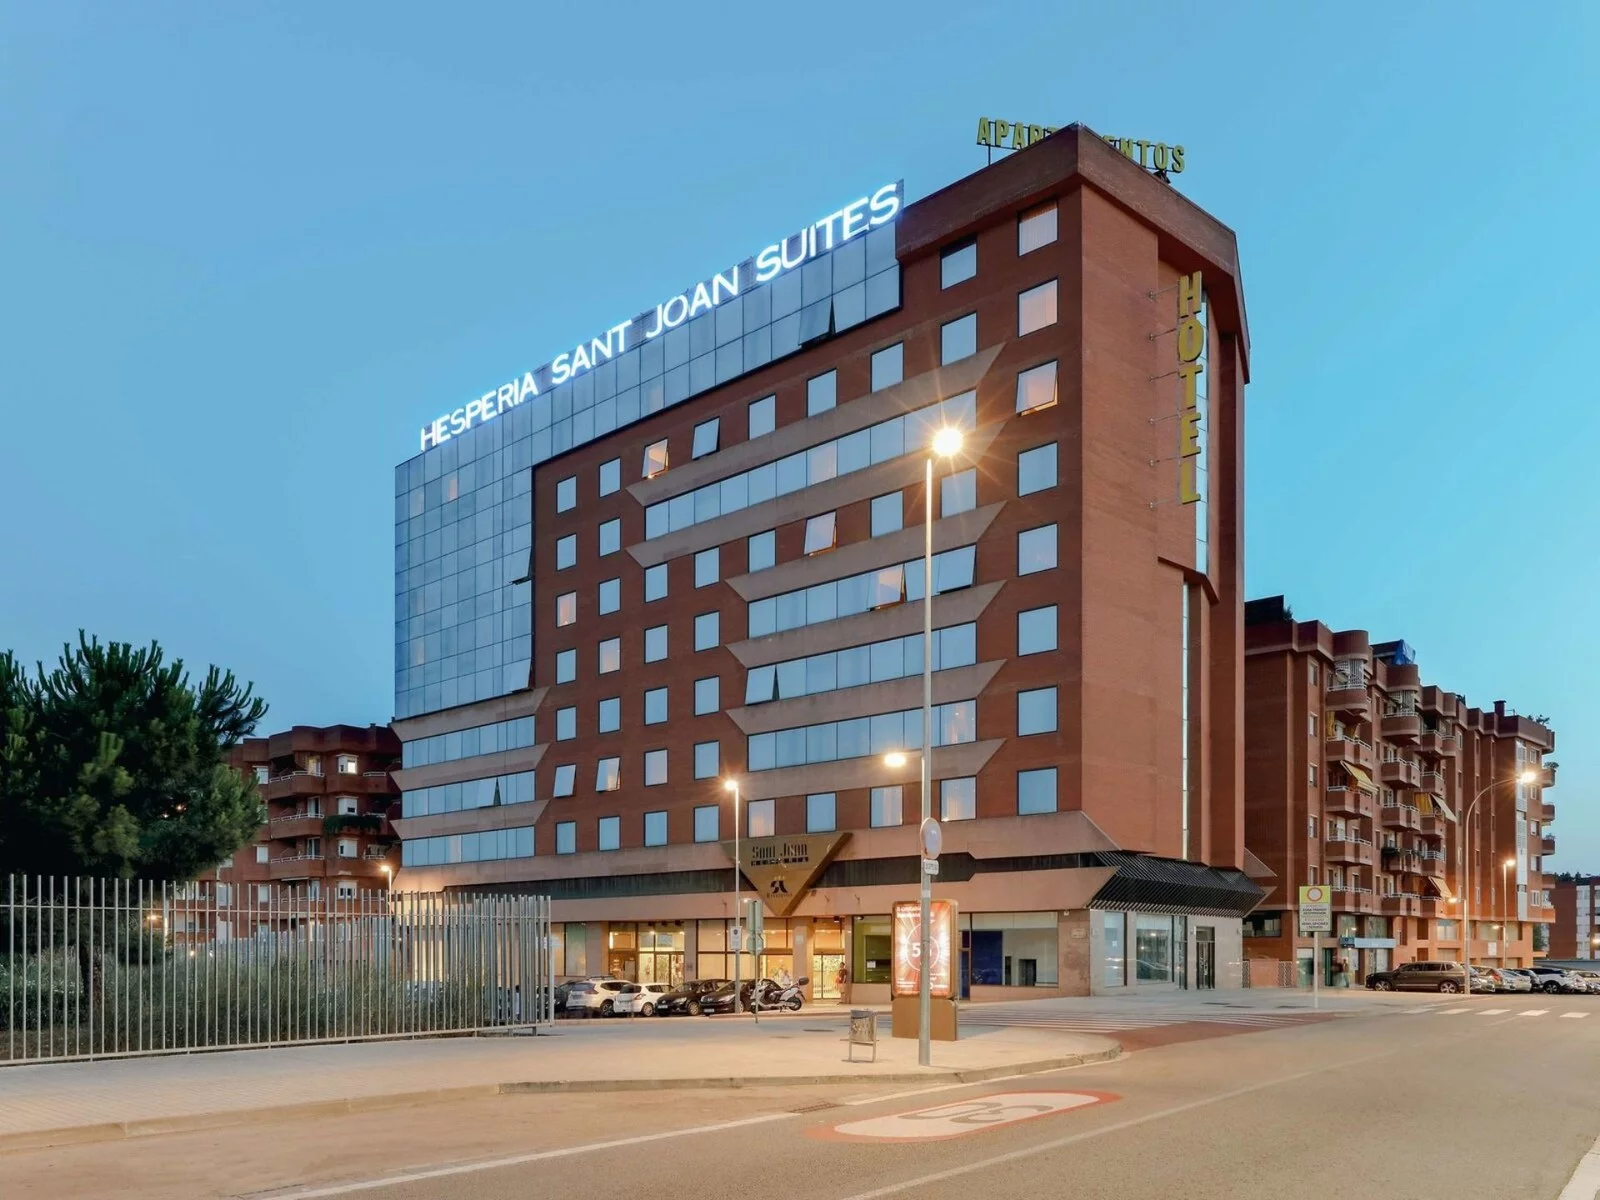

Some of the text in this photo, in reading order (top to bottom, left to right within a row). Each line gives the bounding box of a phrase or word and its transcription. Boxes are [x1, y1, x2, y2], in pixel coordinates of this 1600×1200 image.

[420, 183, 900, 451] HESPERIA SANT JOAN SUITES
[1178, 270, 1204, 505] HOTEL
